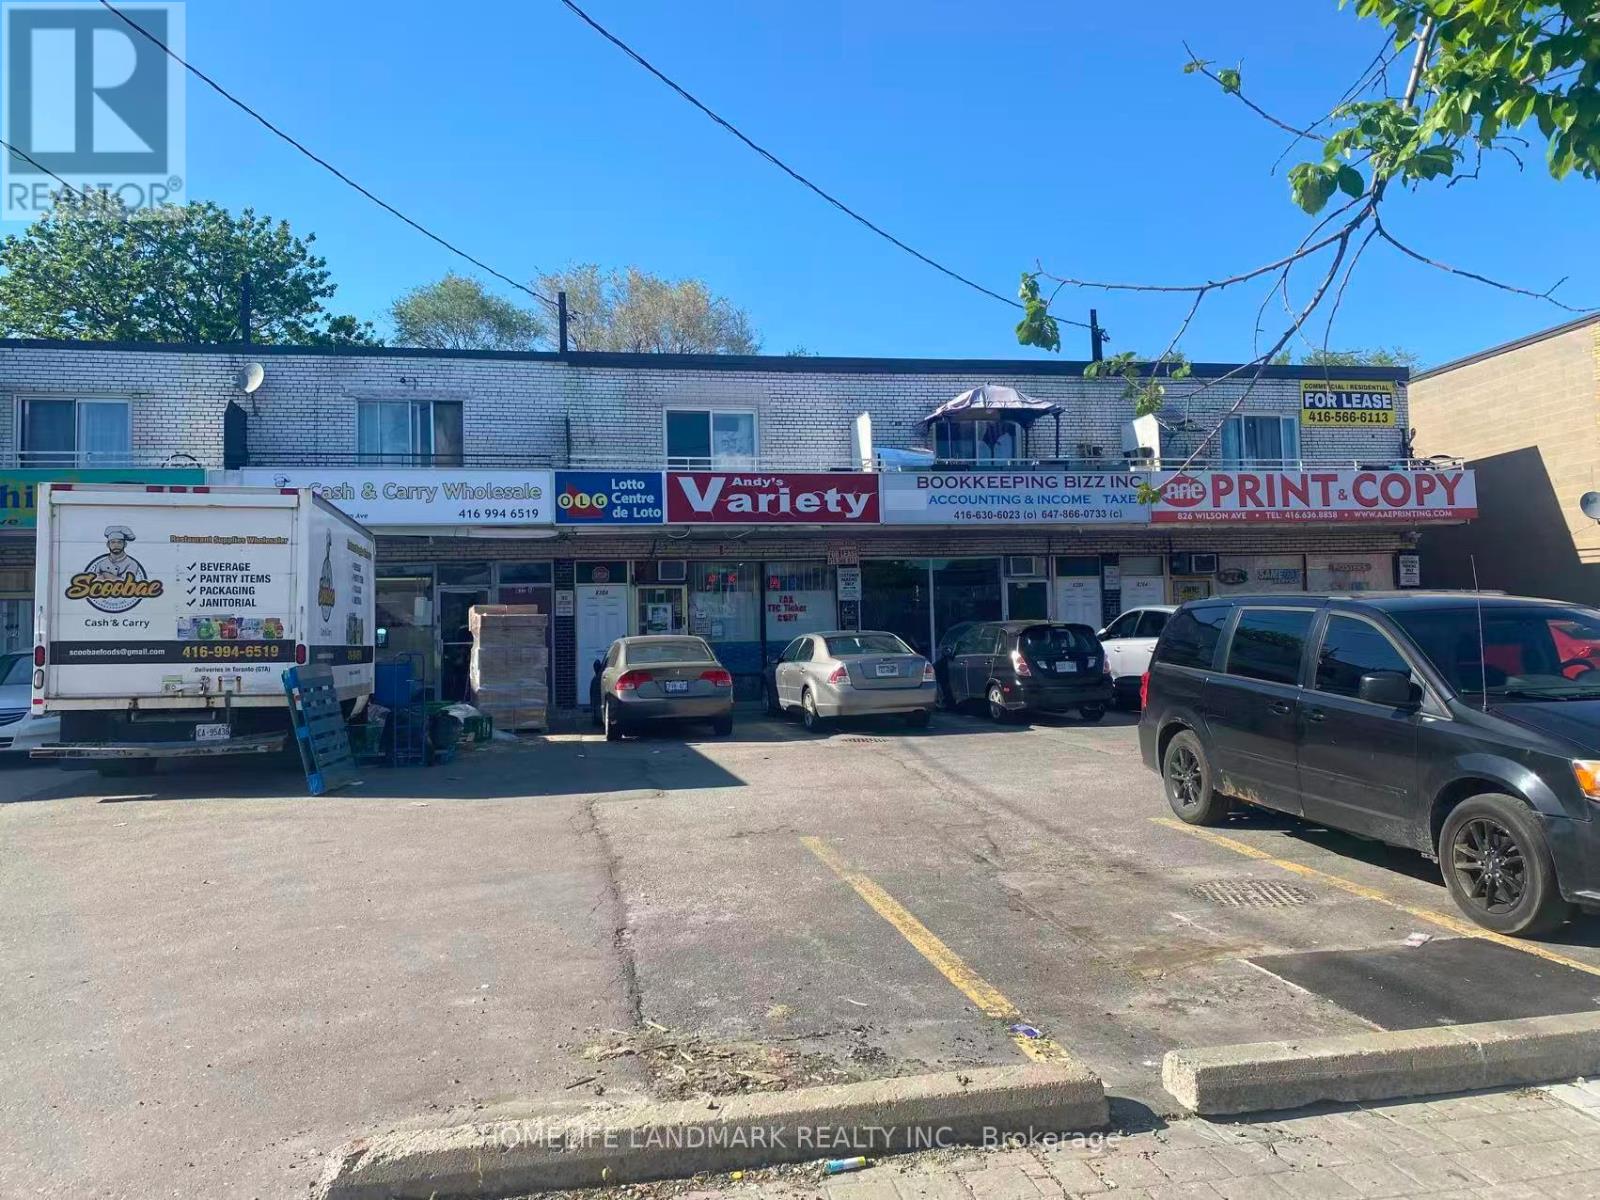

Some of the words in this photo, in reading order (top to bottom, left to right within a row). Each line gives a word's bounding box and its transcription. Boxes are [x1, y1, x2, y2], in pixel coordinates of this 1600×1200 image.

[1305, 393, 1337, 408] FOR
[1342, 394, 1392, 409] LEASE
[1308, 411, 1389, 423] 416-566-6113
[611, 478, 646, 490] Lotto
[731, 477, 784, 487] Andy's
[916, 475, 1058, 489] BOOKKEEPING
[1064, 475, 1105, 488] BIZZ
[309, 482, 355, 500] Cash
[360, 482, 378, 500] &
[382, 482, 438, 503] Carry
[442, 482, 543, 500] Wholesale
[1211, 473, 1338, 508] PRINT
[1338, 488, 1348, 501] &
[1352, 472, 1464, 508] COPY
[558, 493, 608, 509] OLG
[611, 492, 655, 504] Centre
[677, 476, 876, 519] Variety
[929, 495, 1021, 504] ACCOUNTING
[1025, 495, 1034, 504] &
[1037, 495, 1091, 504] INCOME
[458, 508, 481, 519] 416
[484, 508, 506, 519] 994
[511, 508, 539, 519] 6519
[612, 506, 628, 518] de
[633, 507, 661, 518] Loto
[953, 510, 1021, 520] 416-630-6023
[1023, 510, 1037, 520] (o)
[1041, 509, 1107, 519] 647-866-0733
[1109, 509, 1123, 519] (c)
[1177, 512, 1193, 520] 826
[1195, 512, 1228, 520] WILSON
[1231, 512, 1247, 520] AVE
[1354, 510, 1452, 518] WWW.AAEPRINTING.COM
[200, 563, 251, 571] BEVERAGE
[200, 575, 239, 583] PANTRY
[241, 575, 271, 583] ITEMS
[65, 572, 164, 600] Scoobae
[200, 586, 255, 595] PACKAGING
[199, 598, 257, 607] JANITORIAL
[84, 619, 109, 627] Cash
[122, 620, 150, 629] Carry
[182, 645, 279, 658] 416-994-6519
